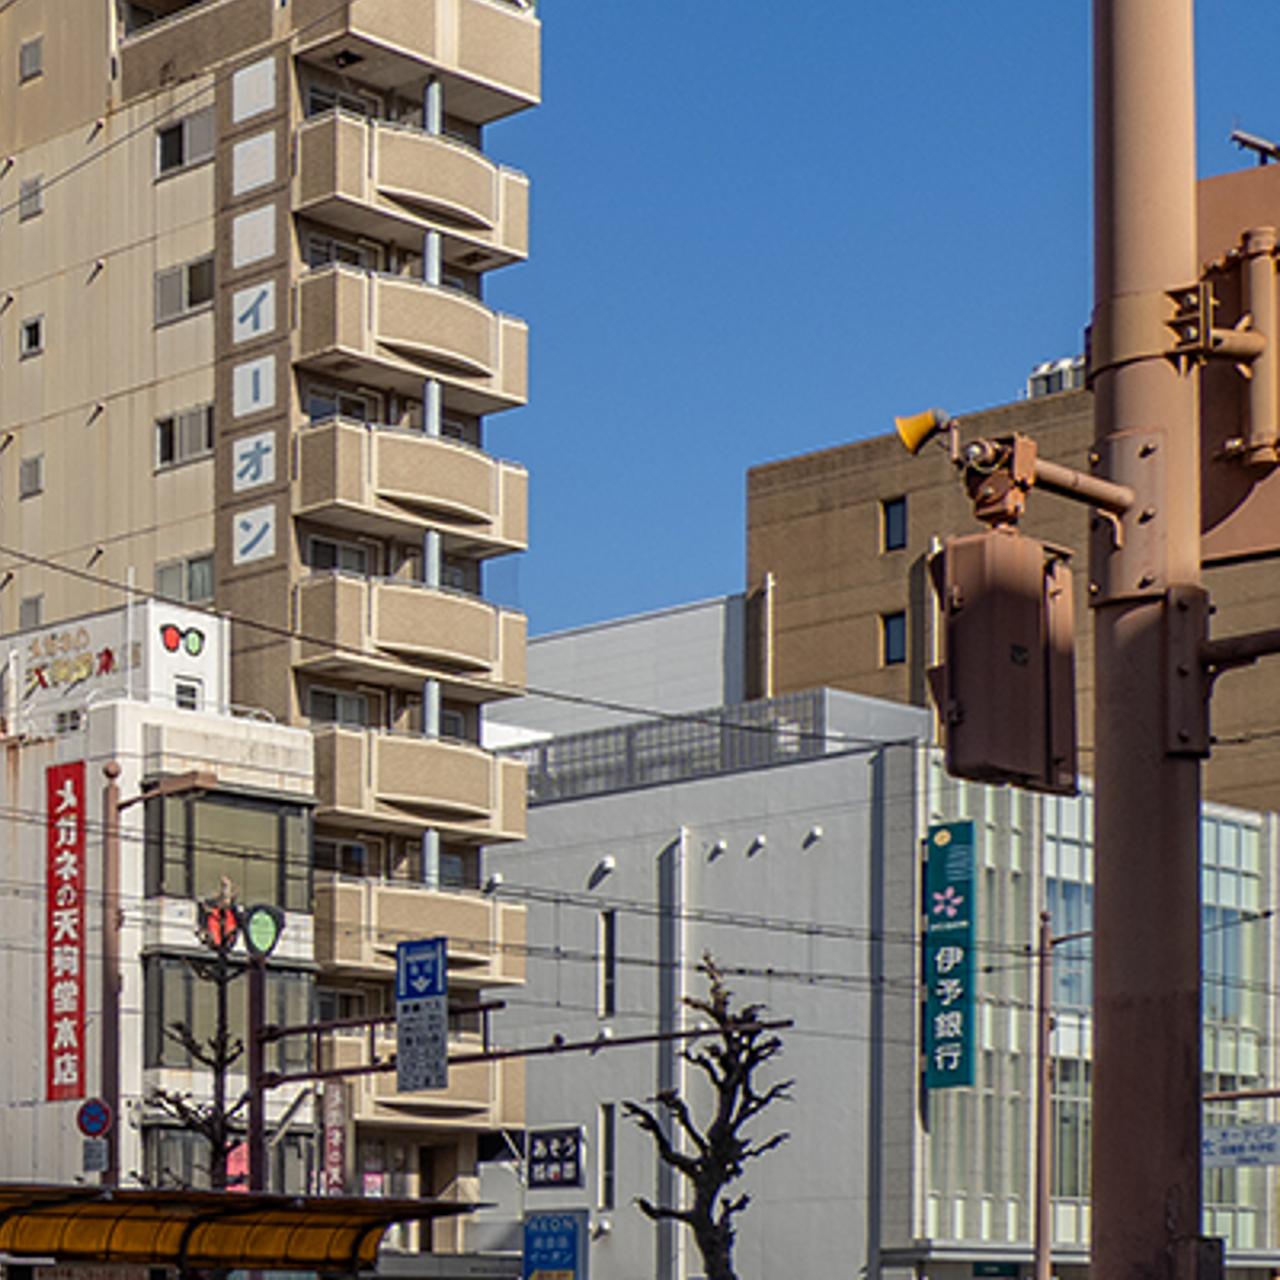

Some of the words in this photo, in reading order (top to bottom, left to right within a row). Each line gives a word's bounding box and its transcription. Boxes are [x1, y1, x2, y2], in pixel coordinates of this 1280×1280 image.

[237, 289, 271, 556] イーオン
[52, 778, 79, 1087] メガネの天狗堂本店
[934, 945, 965, 1070] 伊予銀行
